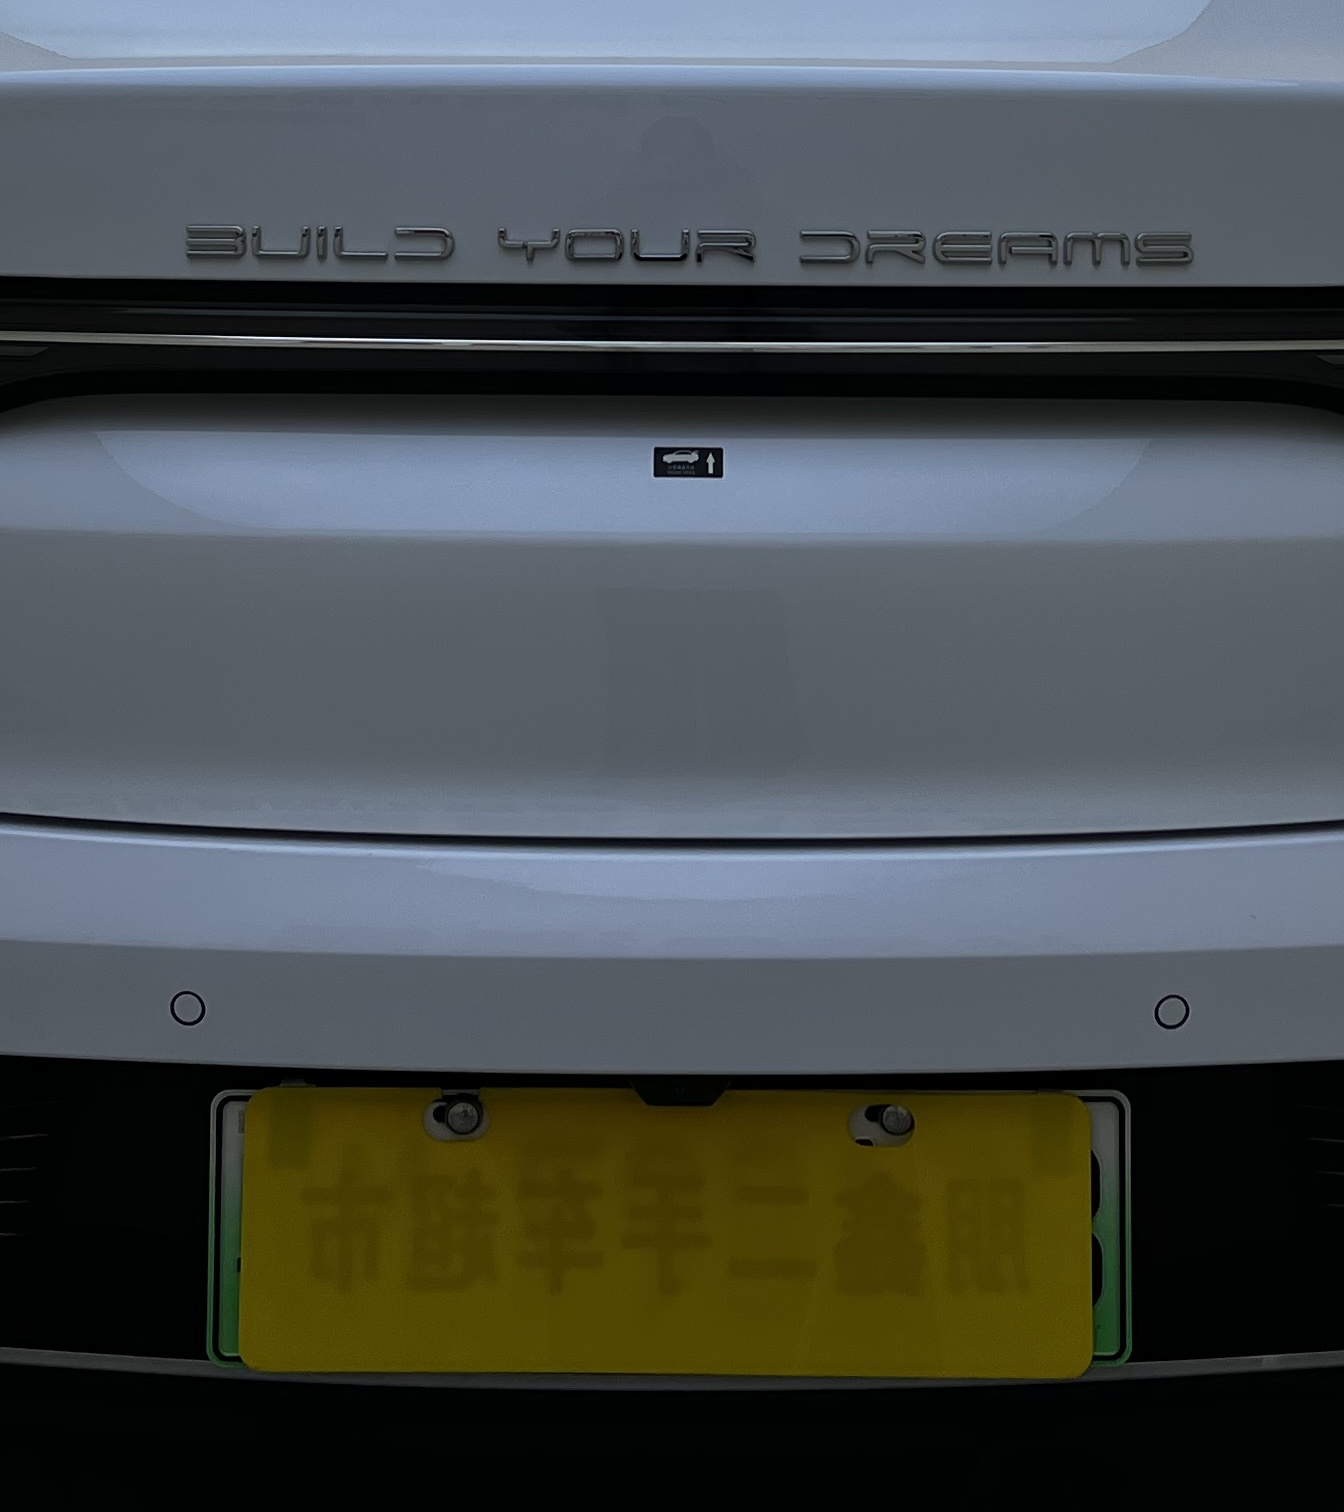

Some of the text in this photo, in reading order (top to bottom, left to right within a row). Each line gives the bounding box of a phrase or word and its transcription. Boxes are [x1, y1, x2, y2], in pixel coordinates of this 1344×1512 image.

[185, 223, 1194, 268] BUILD YOUR DREAMS
